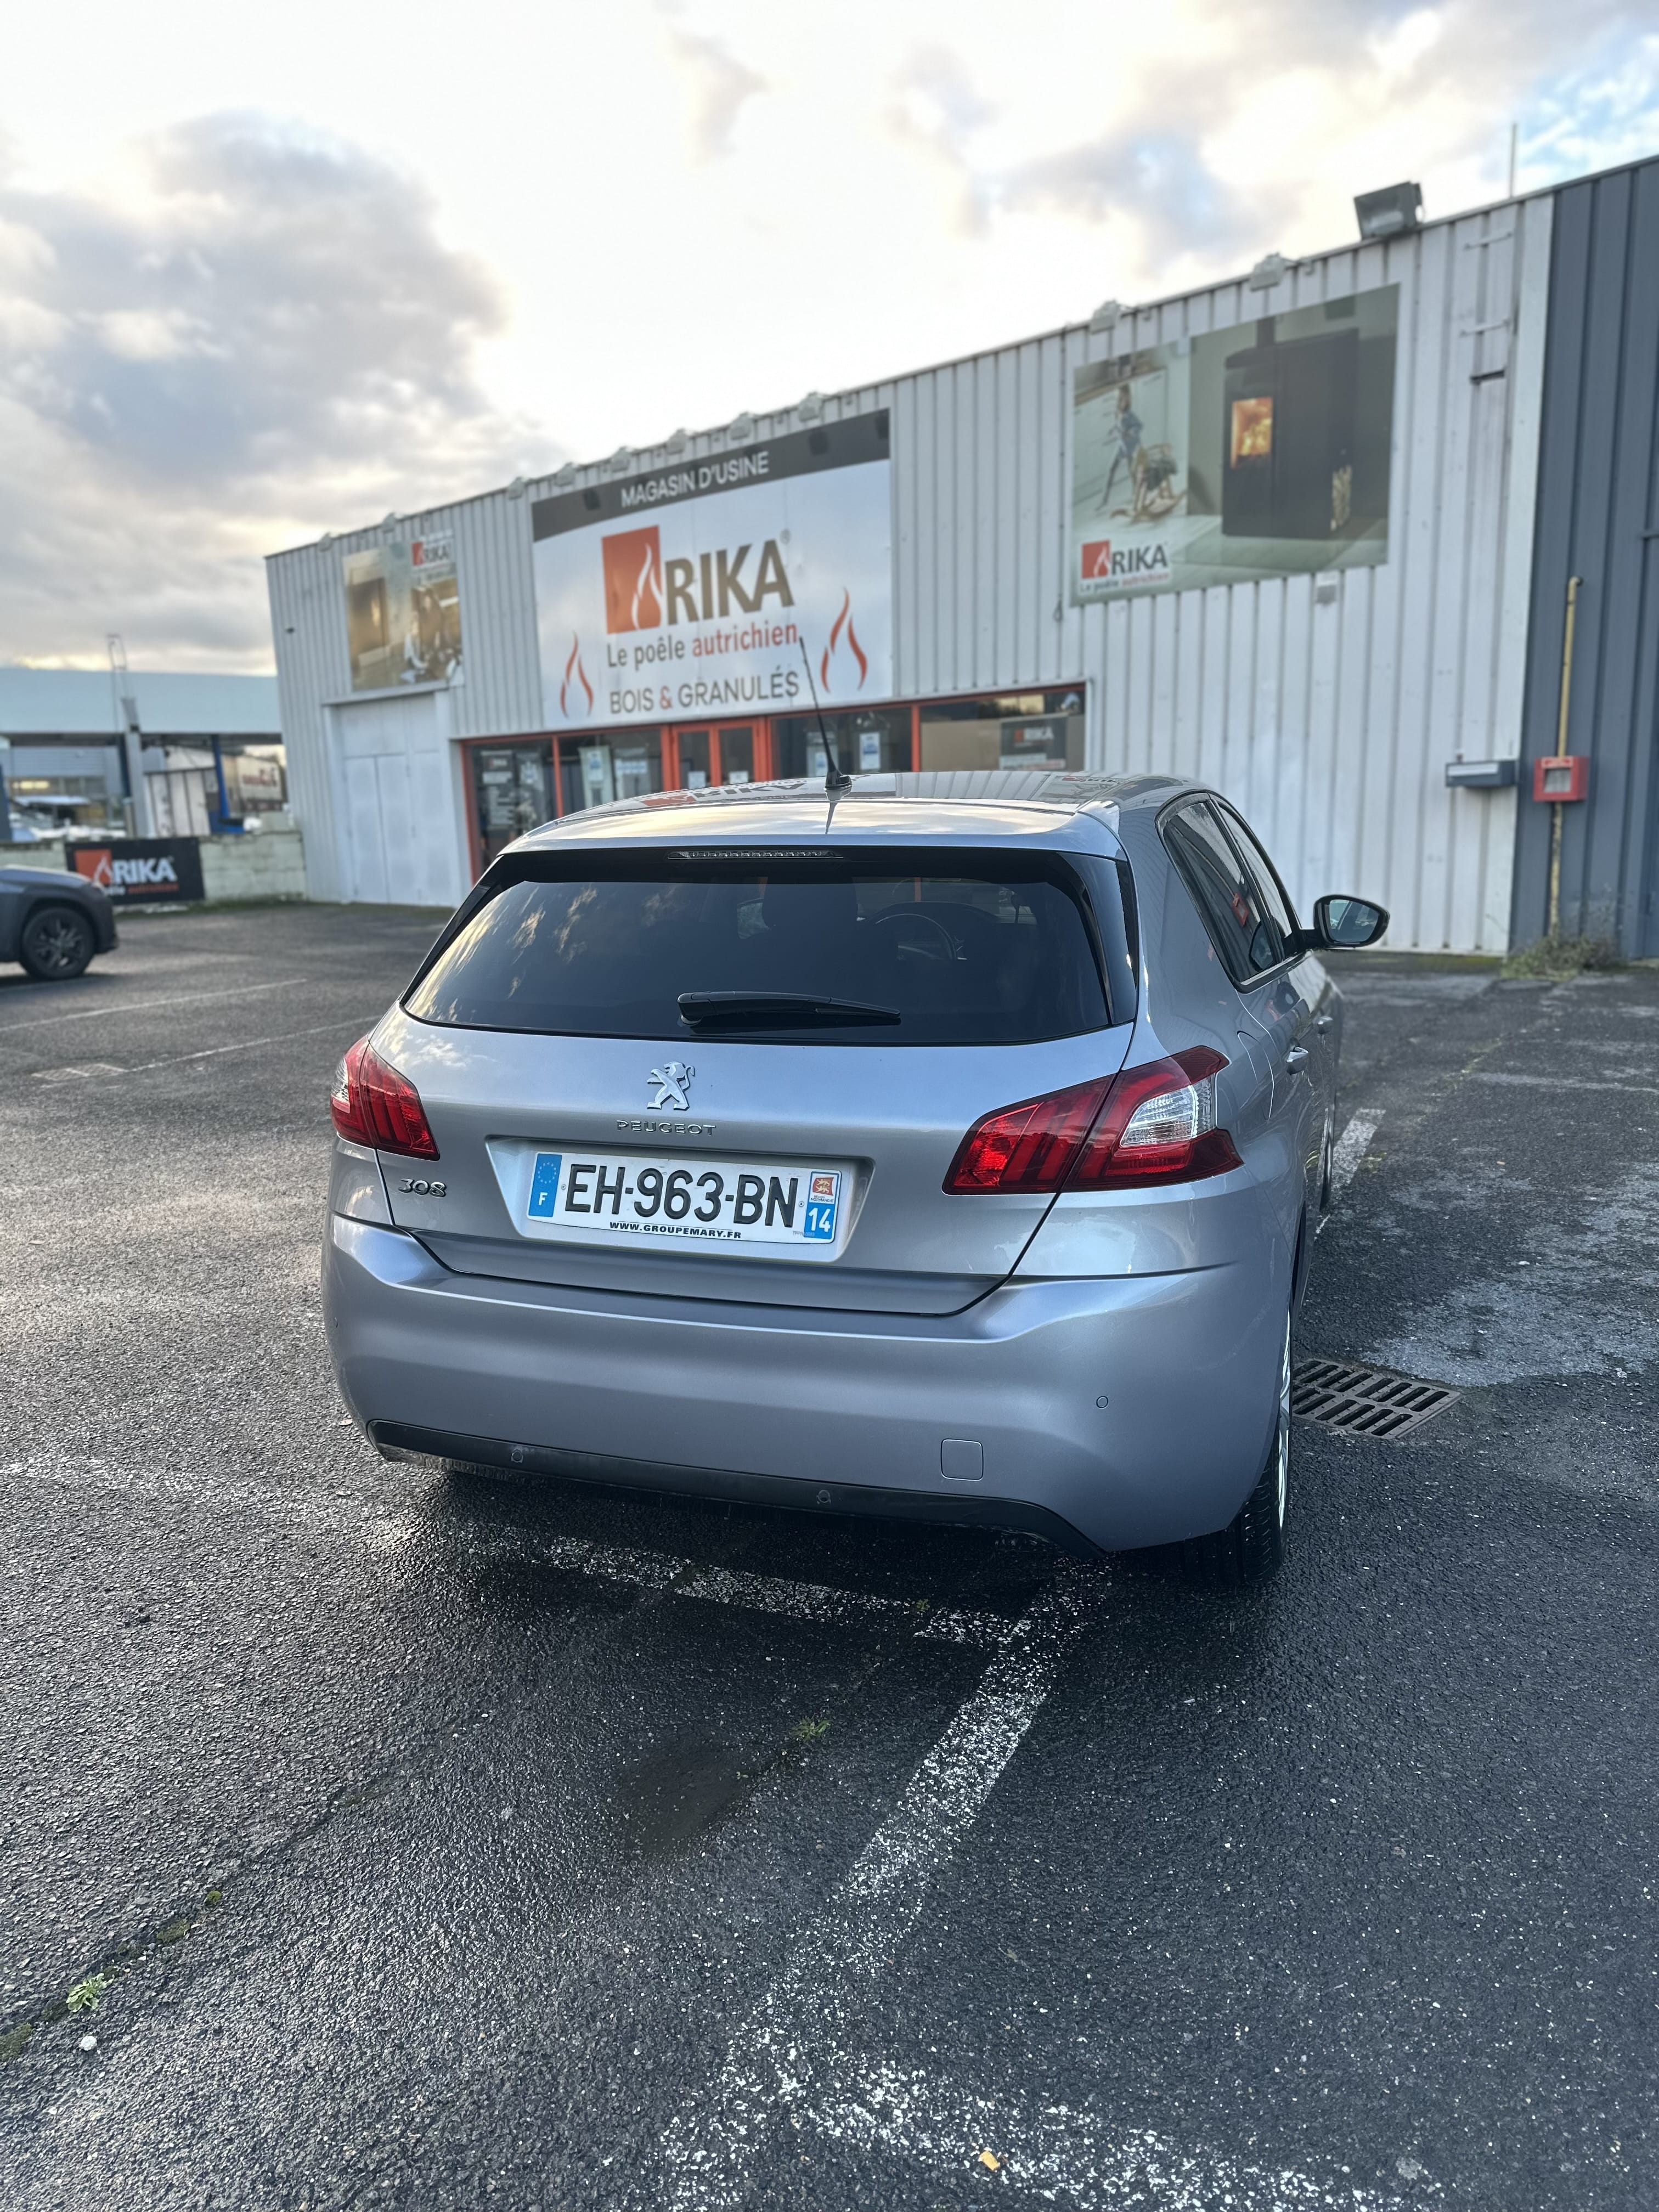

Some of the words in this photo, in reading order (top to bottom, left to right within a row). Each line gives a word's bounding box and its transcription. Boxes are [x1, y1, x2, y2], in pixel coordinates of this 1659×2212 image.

[621, 471, 696, 507] MAGASIN
[698, 451, 769, 488] D'USINE
[1112, 545, 1167, 575] RIKA
[664, 539, 795, 625] RIKA
[607, 643, 627, 668] Le
[635, 635, 685, 672] poêle
[692, 620, 798, 657] autrichien
[610, 687, 654, 714] BOIS
[659, 686, 672, 709] &
[678, 665, 799, 708] GRANULÉS
[112, 857, 177, 885] RIKA
[616, 1120, 716, 1136] PEUGEOT
[398, 1178, 447, 1198] 308
[538, 1192, 548, 1206] F
[565, 1164, 799, 1228] EH-963-BN
[610, 1222, 741, 1239] WWW.GROUPEMARY.FR
[809, 1207, 831, 1232] 14
